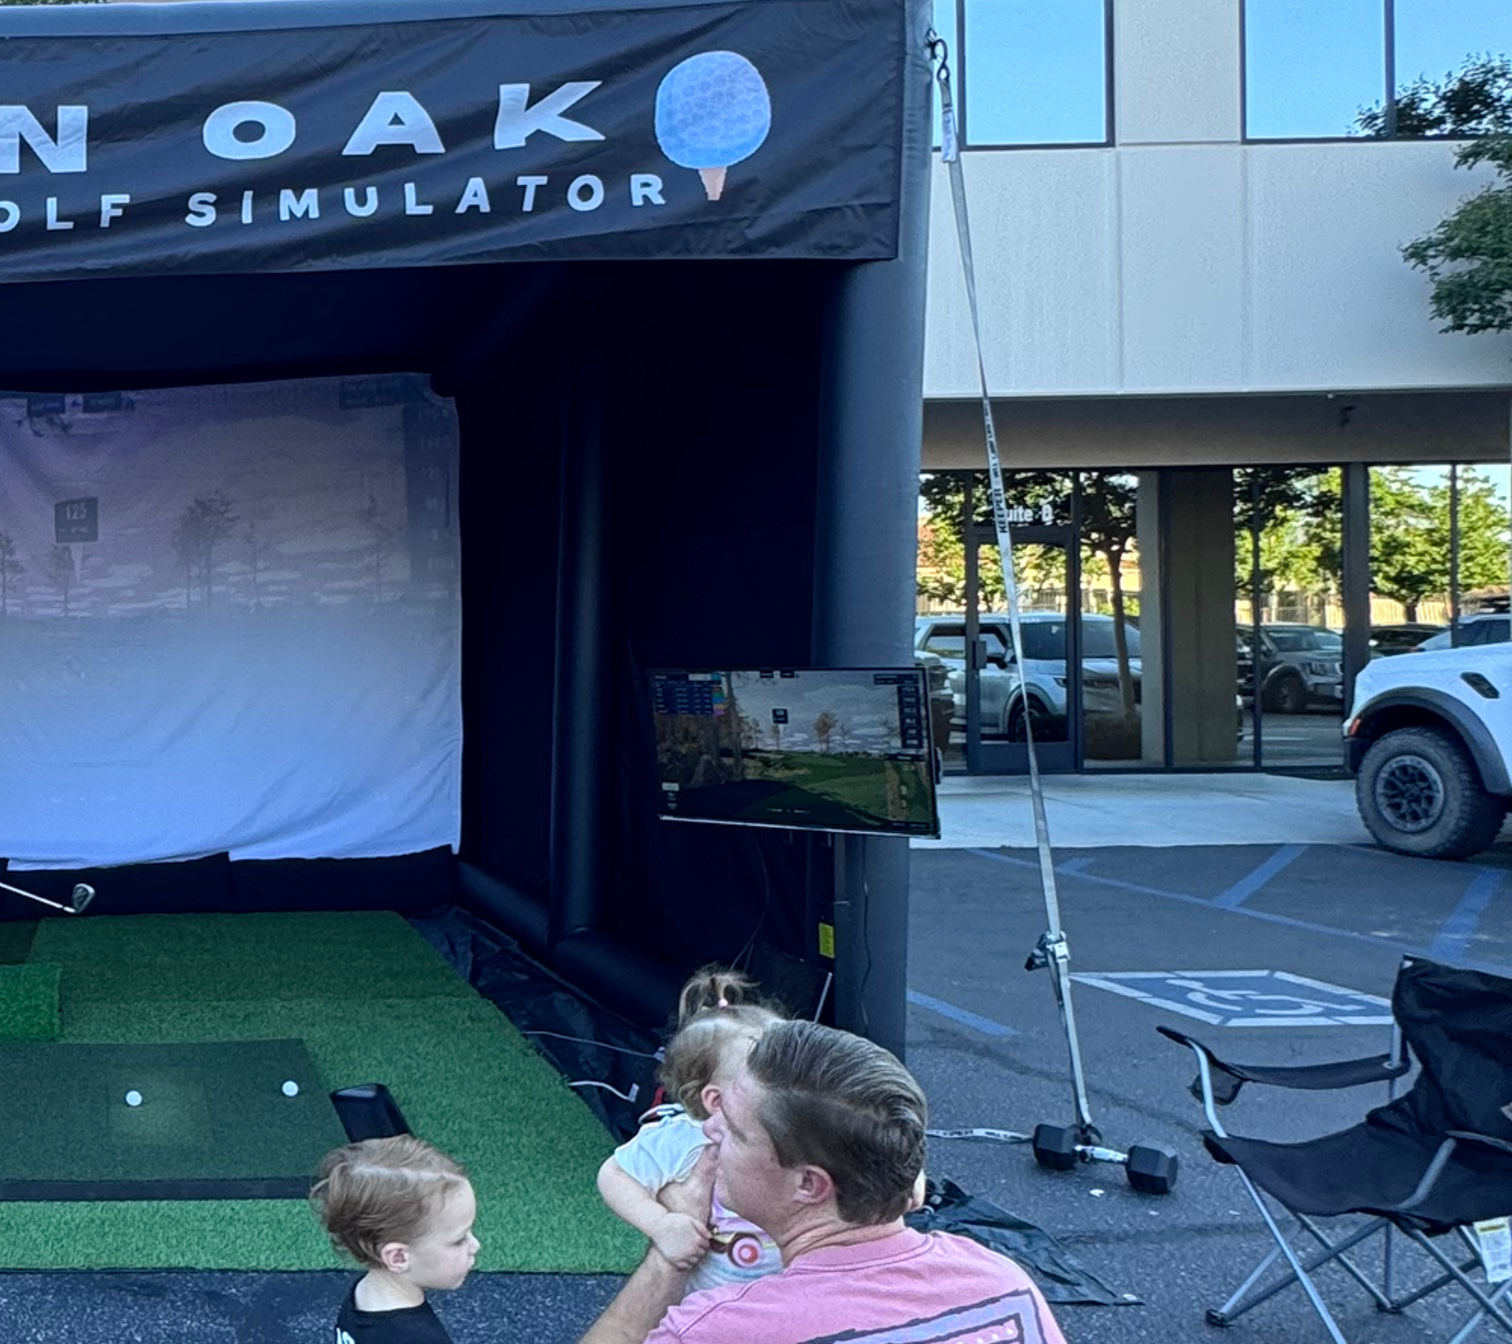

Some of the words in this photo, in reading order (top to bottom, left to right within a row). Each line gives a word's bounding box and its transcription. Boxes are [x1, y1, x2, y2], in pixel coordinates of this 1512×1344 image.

[202, 80, 606, 161] OAK
[185, 173, 666, 227] SIMULATOR
[1006, 505, 1033, 522] uite
